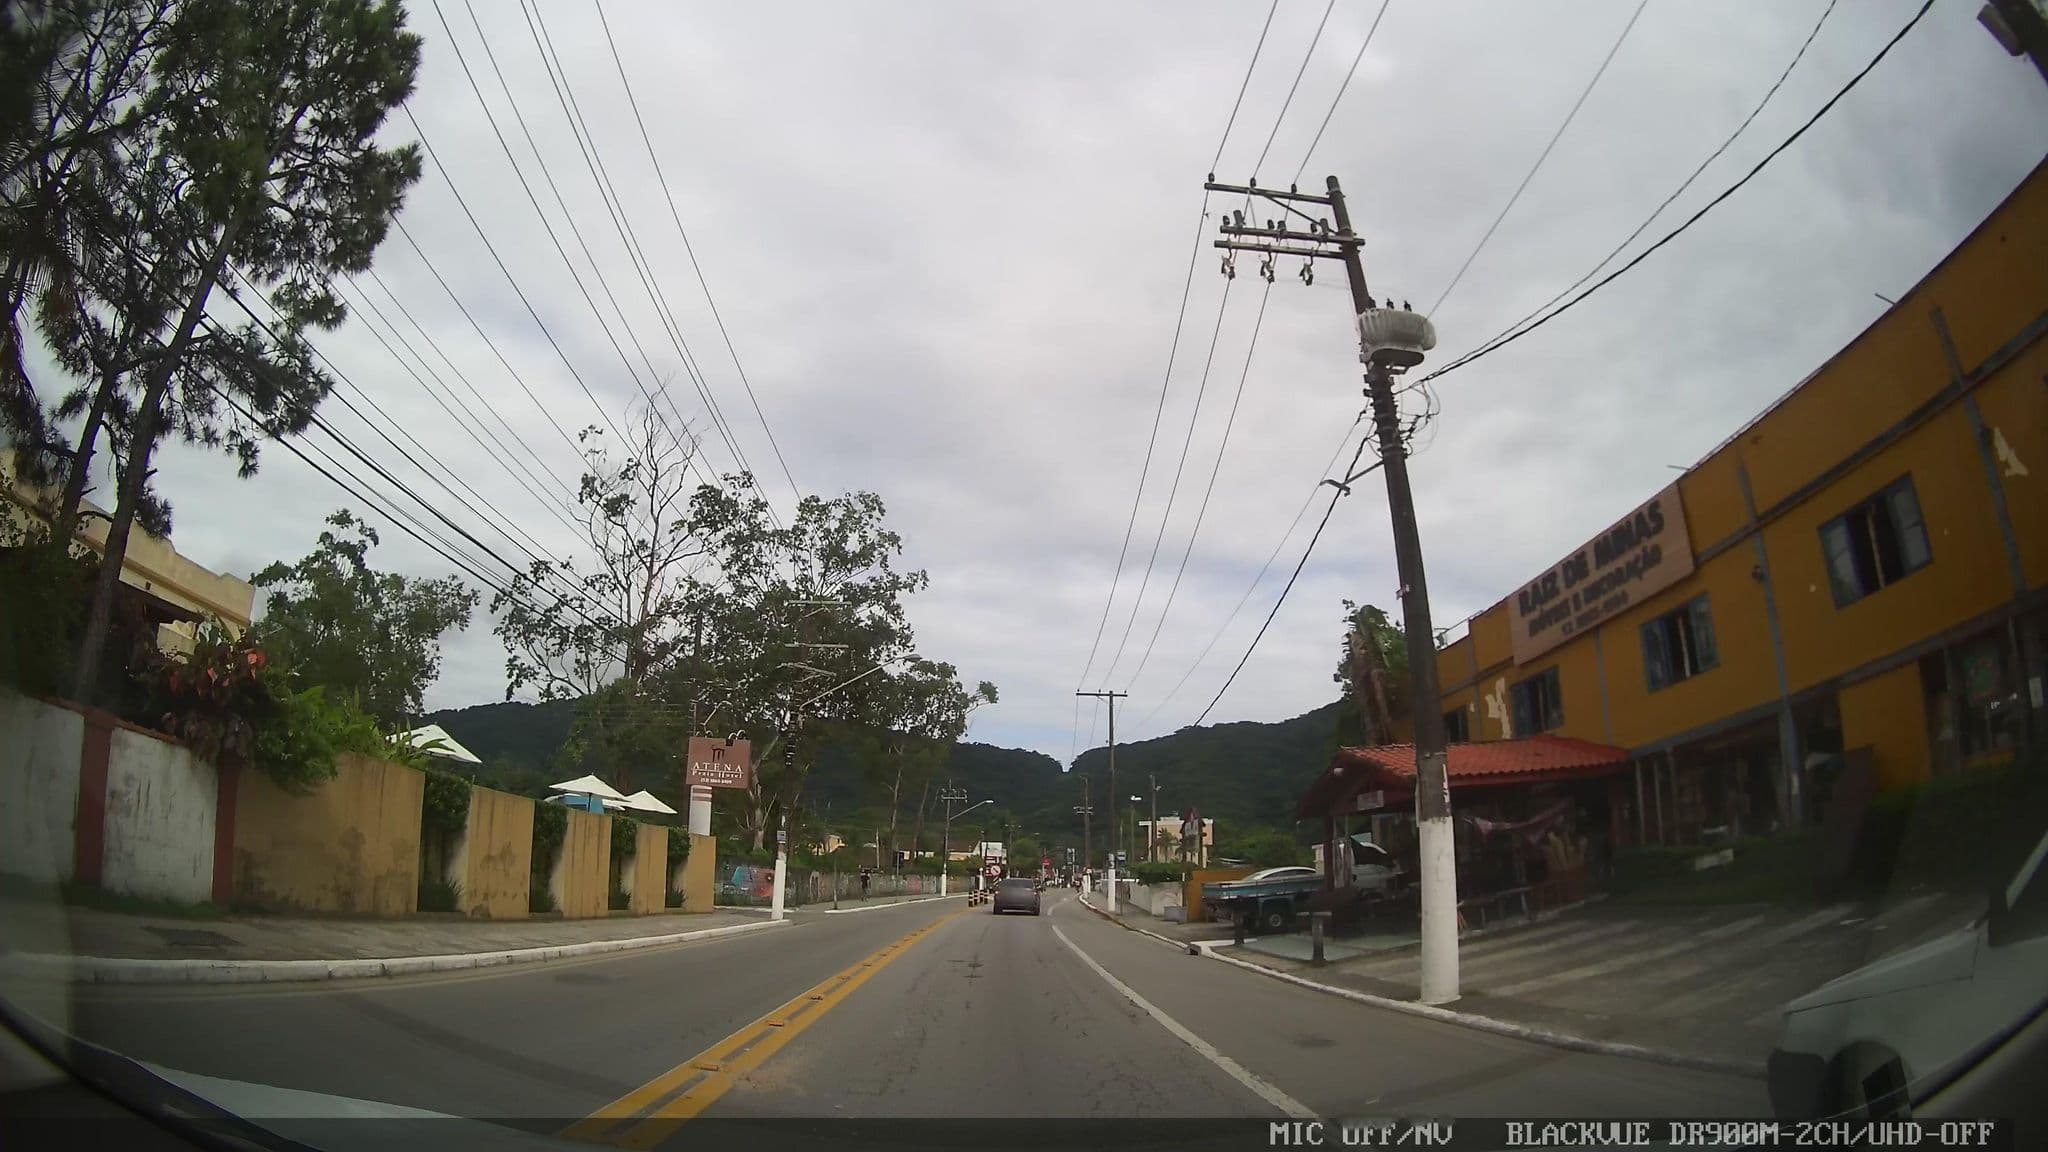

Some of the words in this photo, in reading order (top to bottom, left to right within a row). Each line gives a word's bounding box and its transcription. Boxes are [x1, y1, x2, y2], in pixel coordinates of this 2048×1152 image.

[1517, 571, 1560, 617] RAIZ
[1562, 549, 1590, 589] DE
[1593, 498, 1666, 571] MINAS
[693, 762, 742, 772] ATENA
